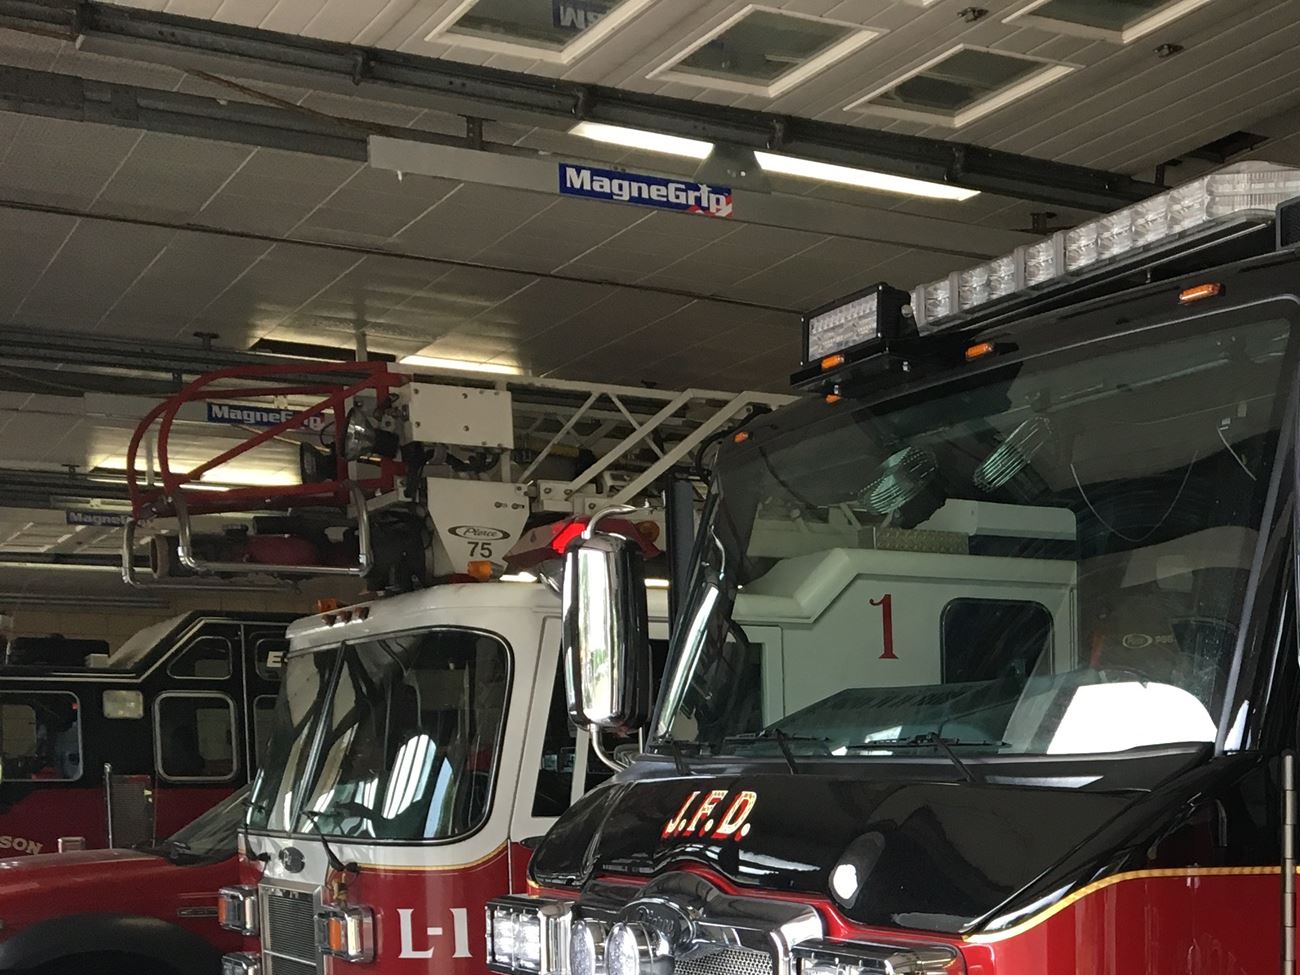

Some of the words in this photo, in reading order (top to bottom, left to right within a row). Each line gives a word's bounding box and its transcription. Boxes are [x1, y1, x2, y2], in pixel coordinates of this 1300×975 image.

[566, 167, 729, 213] MagneGrip
[211, 404, 321, 431] MagneGp
[467, 542, 493, 558] 75
[869, 593, 899, 659] 1
[662, 789, 757, 841] J.F.D.
[396, 907, 473, 959] L-1
